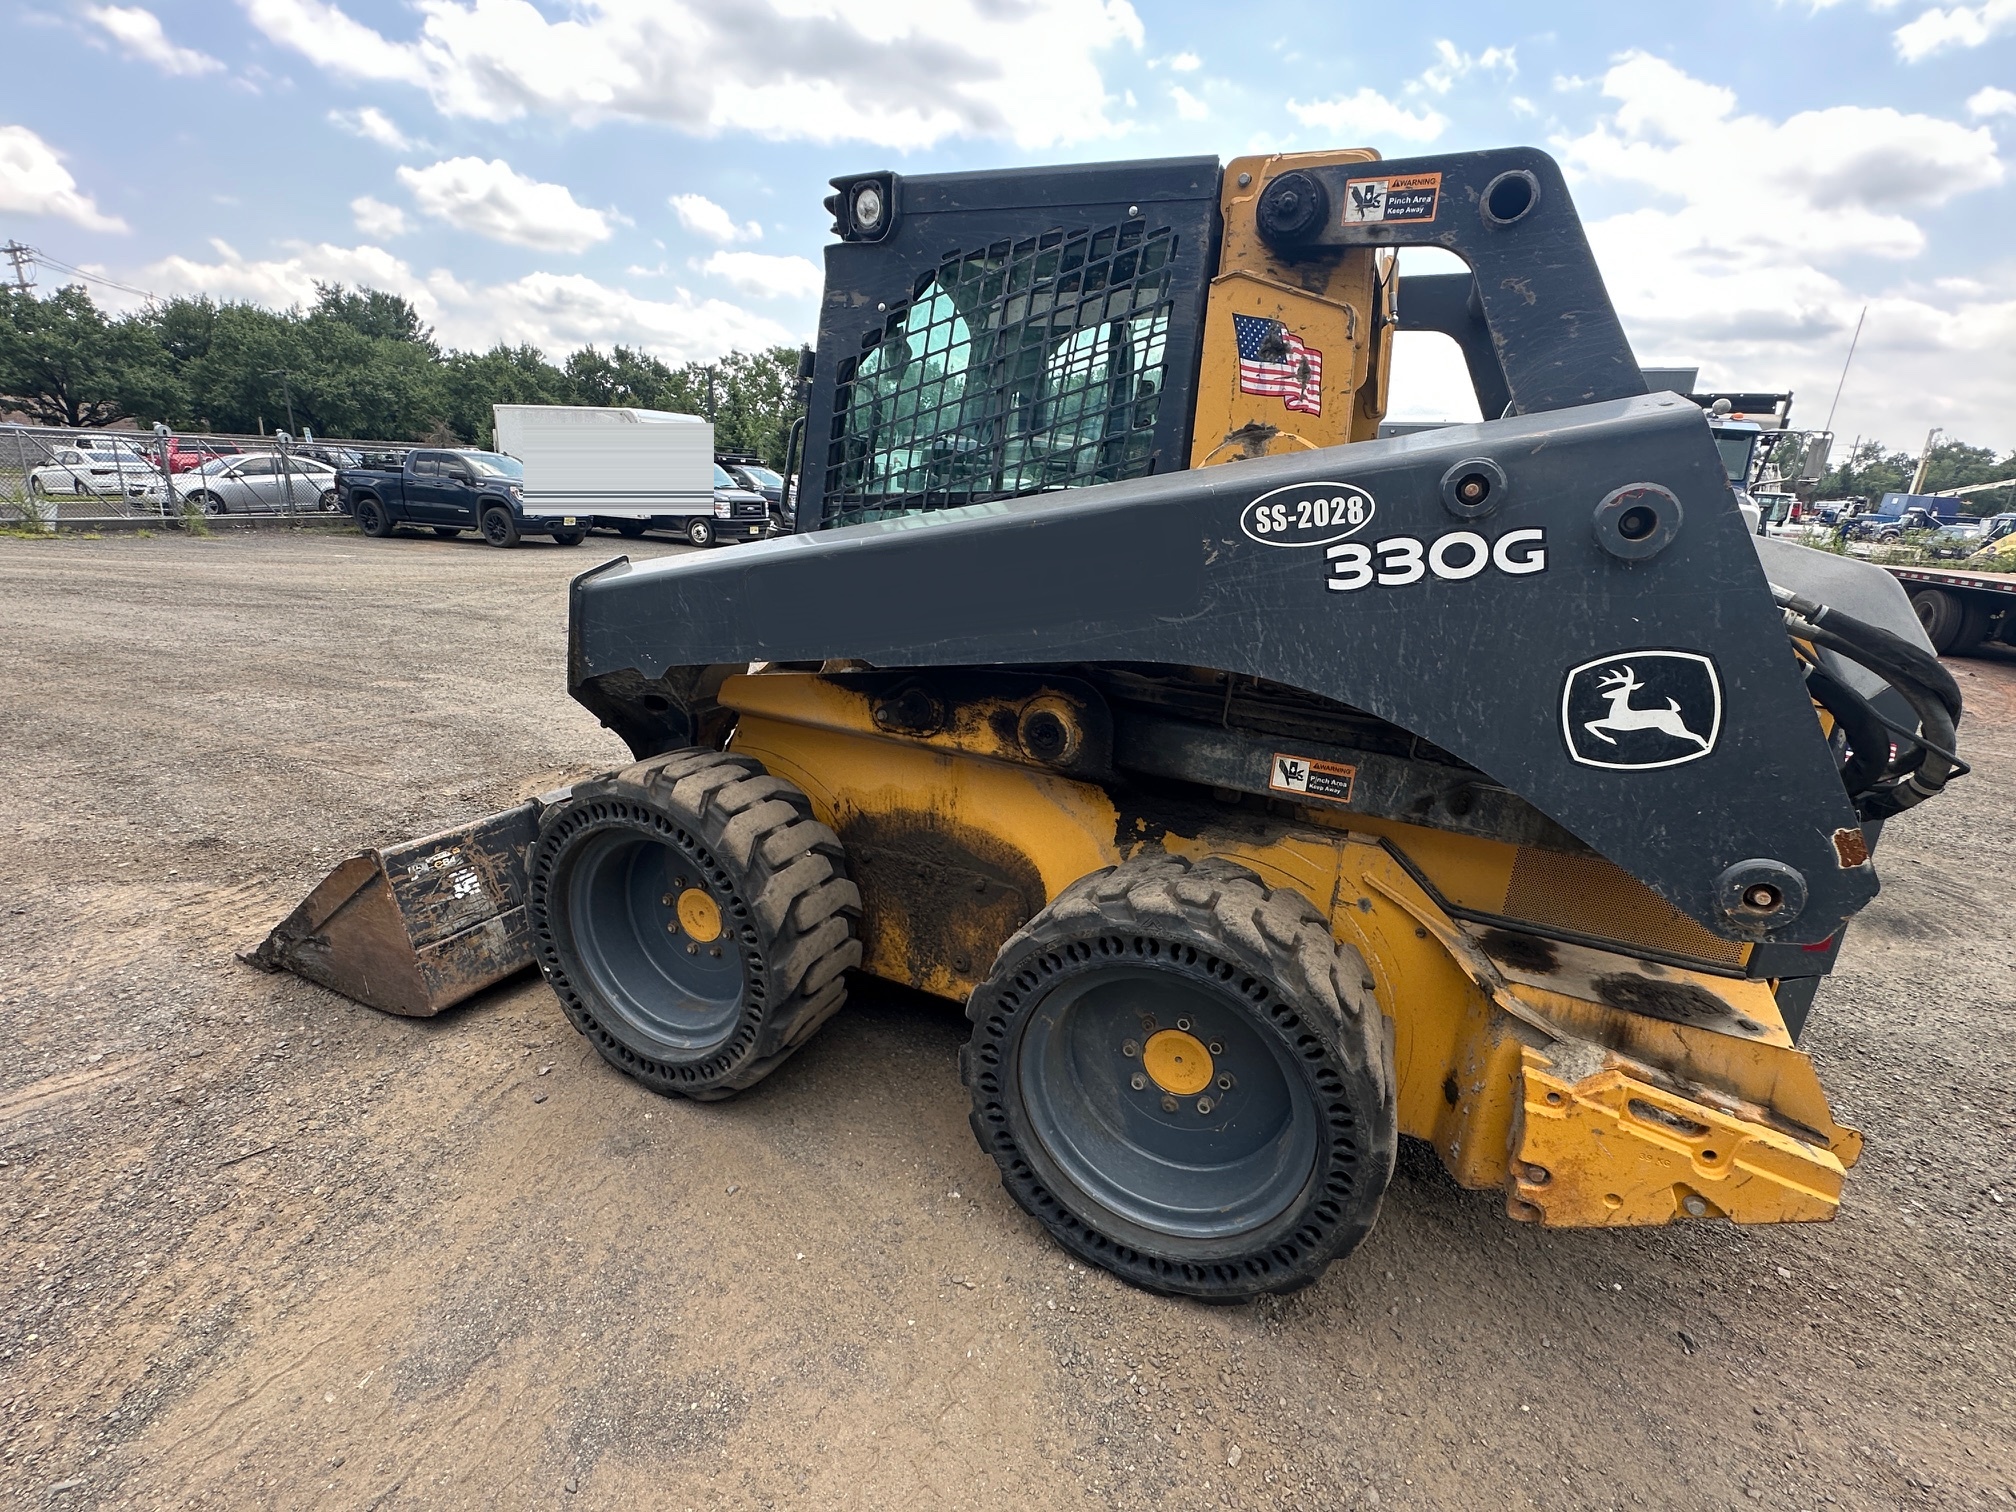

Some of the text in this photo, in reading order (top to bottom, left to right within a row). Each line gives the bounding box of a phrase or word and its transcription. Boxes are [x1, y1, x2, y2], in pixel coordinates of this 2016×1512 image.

[1400, 178, 1436, 186] WARNING
[1388, 196, 1432, 205] Pinch Area
[1255, 496, 1364, 533] SS-2028
[1326, 529, 1545, 591] 330G
[1320, 764, 1351, 774] WARNING
[1310, 775, 1347, 788] Pinch Area
[1308, 783, 1341, 794] Keep Away
